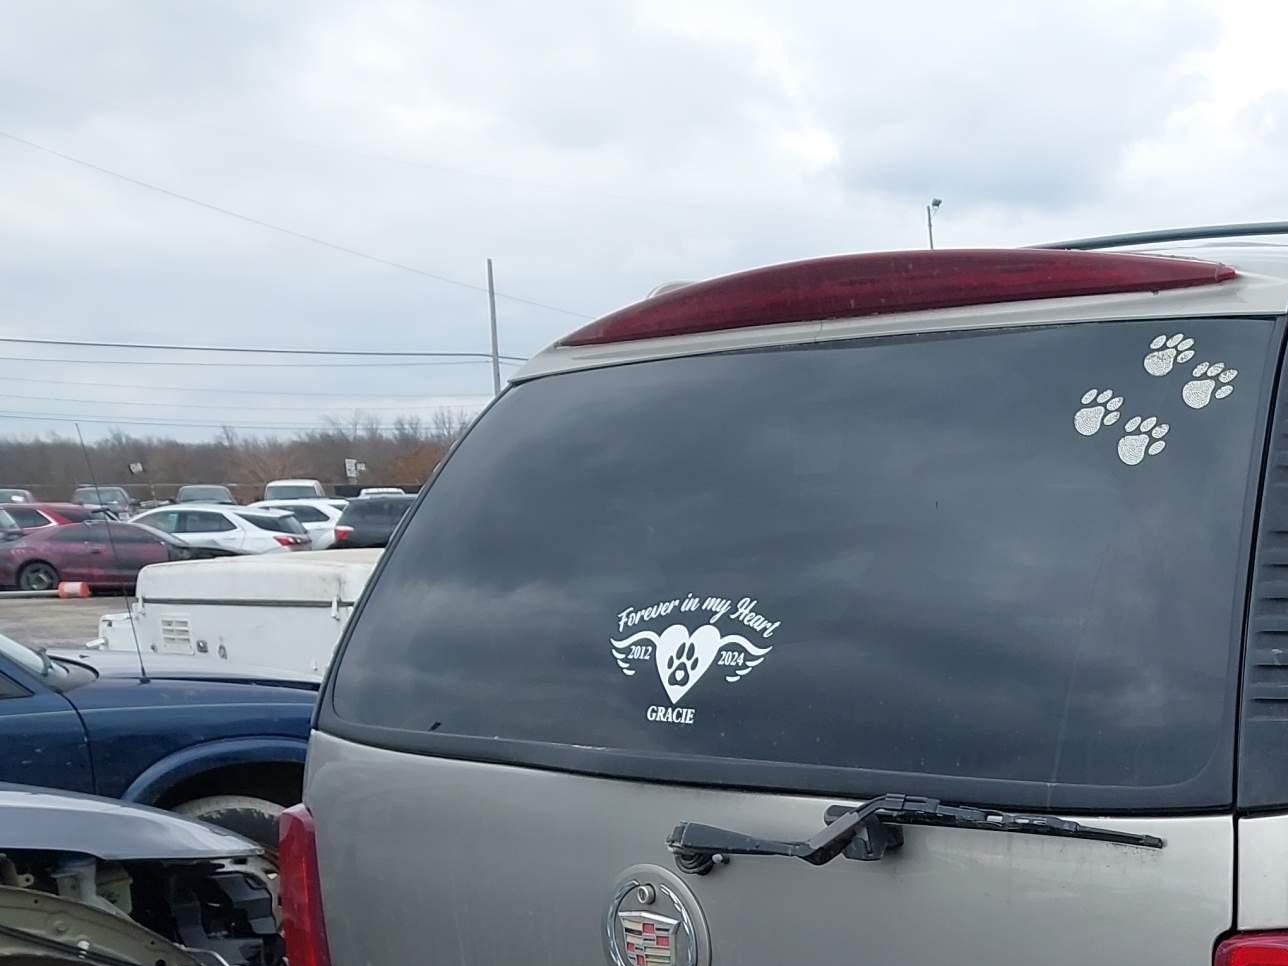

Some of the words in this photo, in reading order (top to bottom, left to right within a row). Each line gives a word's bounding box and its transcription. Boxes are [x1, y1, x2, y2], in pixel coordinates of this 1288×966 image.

[617, 599, 680, 632] Forever
[680, 592, 700, 612] in
[702, 596, 731, 624] my
[729, 597, 781, 638] Heart
[627, 645, 652, 660] 2012
[718, 650, 745, 666] 2024
[646, 705, 695, 724] GRACIE
